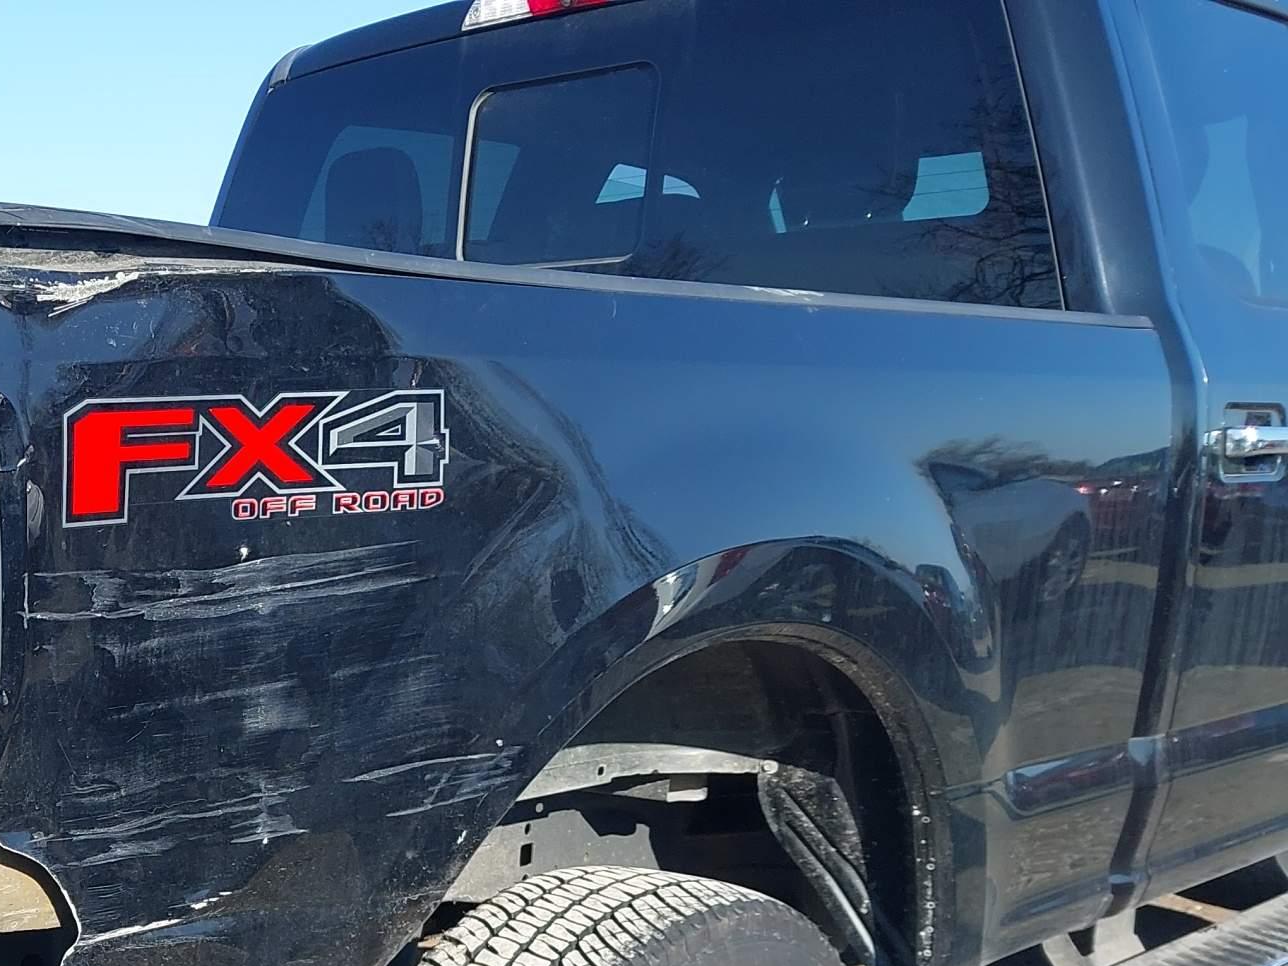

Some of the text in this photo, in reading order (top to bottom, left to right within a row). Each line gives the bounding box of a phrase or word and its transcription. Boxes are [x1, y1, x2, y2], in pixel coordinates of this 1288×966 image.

[63, 389, 450, 528] FX4
[232, 487, 445, 521] OFF ROAD
